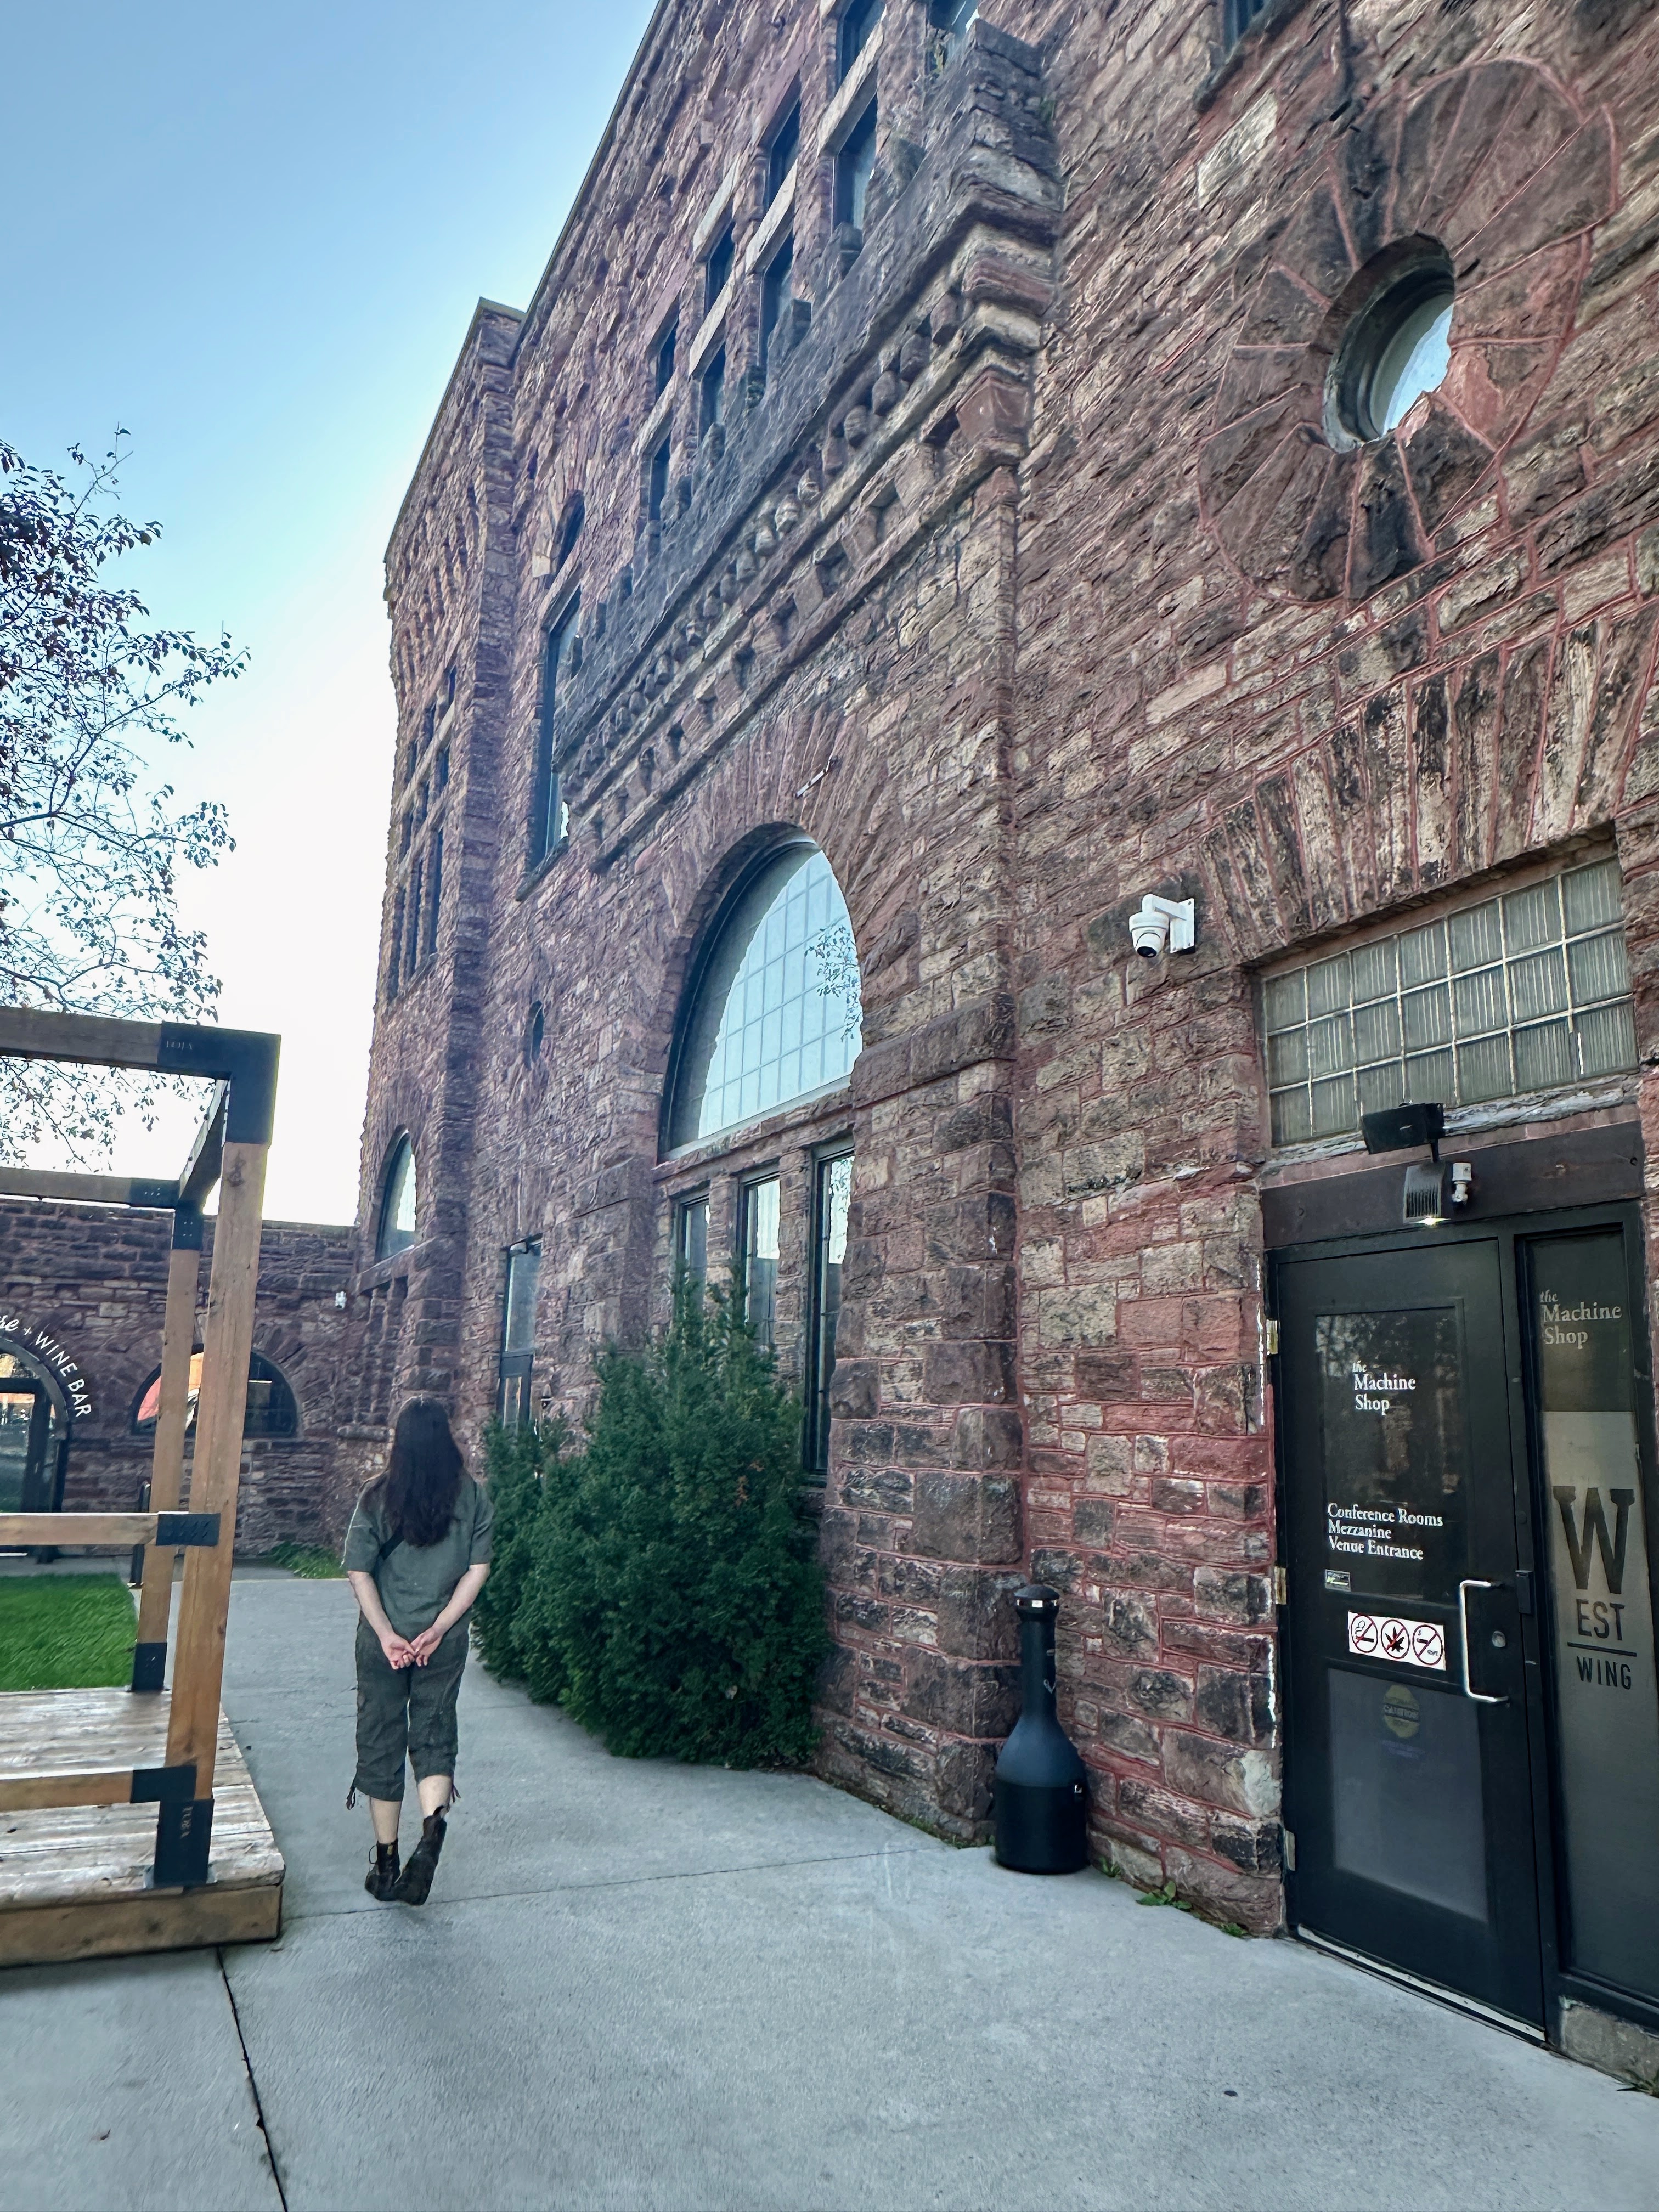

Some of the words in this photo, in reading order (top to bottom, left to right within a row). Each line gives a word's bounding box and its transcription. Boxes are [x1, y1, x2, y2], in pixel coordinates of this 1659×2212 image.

[1540, 1289, 1559, 1303] the
[1541, 1301, 1622, 1322] Machine
[1543, 1325, 1588, 1350] Shop
[35, 1331, 78, 1377] WINE
[67, 1379, 92, 1418] BAR
[1352, 1360, 1367, 1372] the
[1354, 1372, 1417, 1390] Machine
[1355, 1394, 1390, 1415] Shop
[1327, 1503, 1395, 1523] Conference
[1397, 1508, 1444, 1527] Rooms
[1328, 1519, 1392, 1539] Mezzanine
[1328, 1535, 1365, 1554] Venue
[1367, 1539, 1424, 1560] Entrance
[1576, 1656, 1632, 1690] WING
